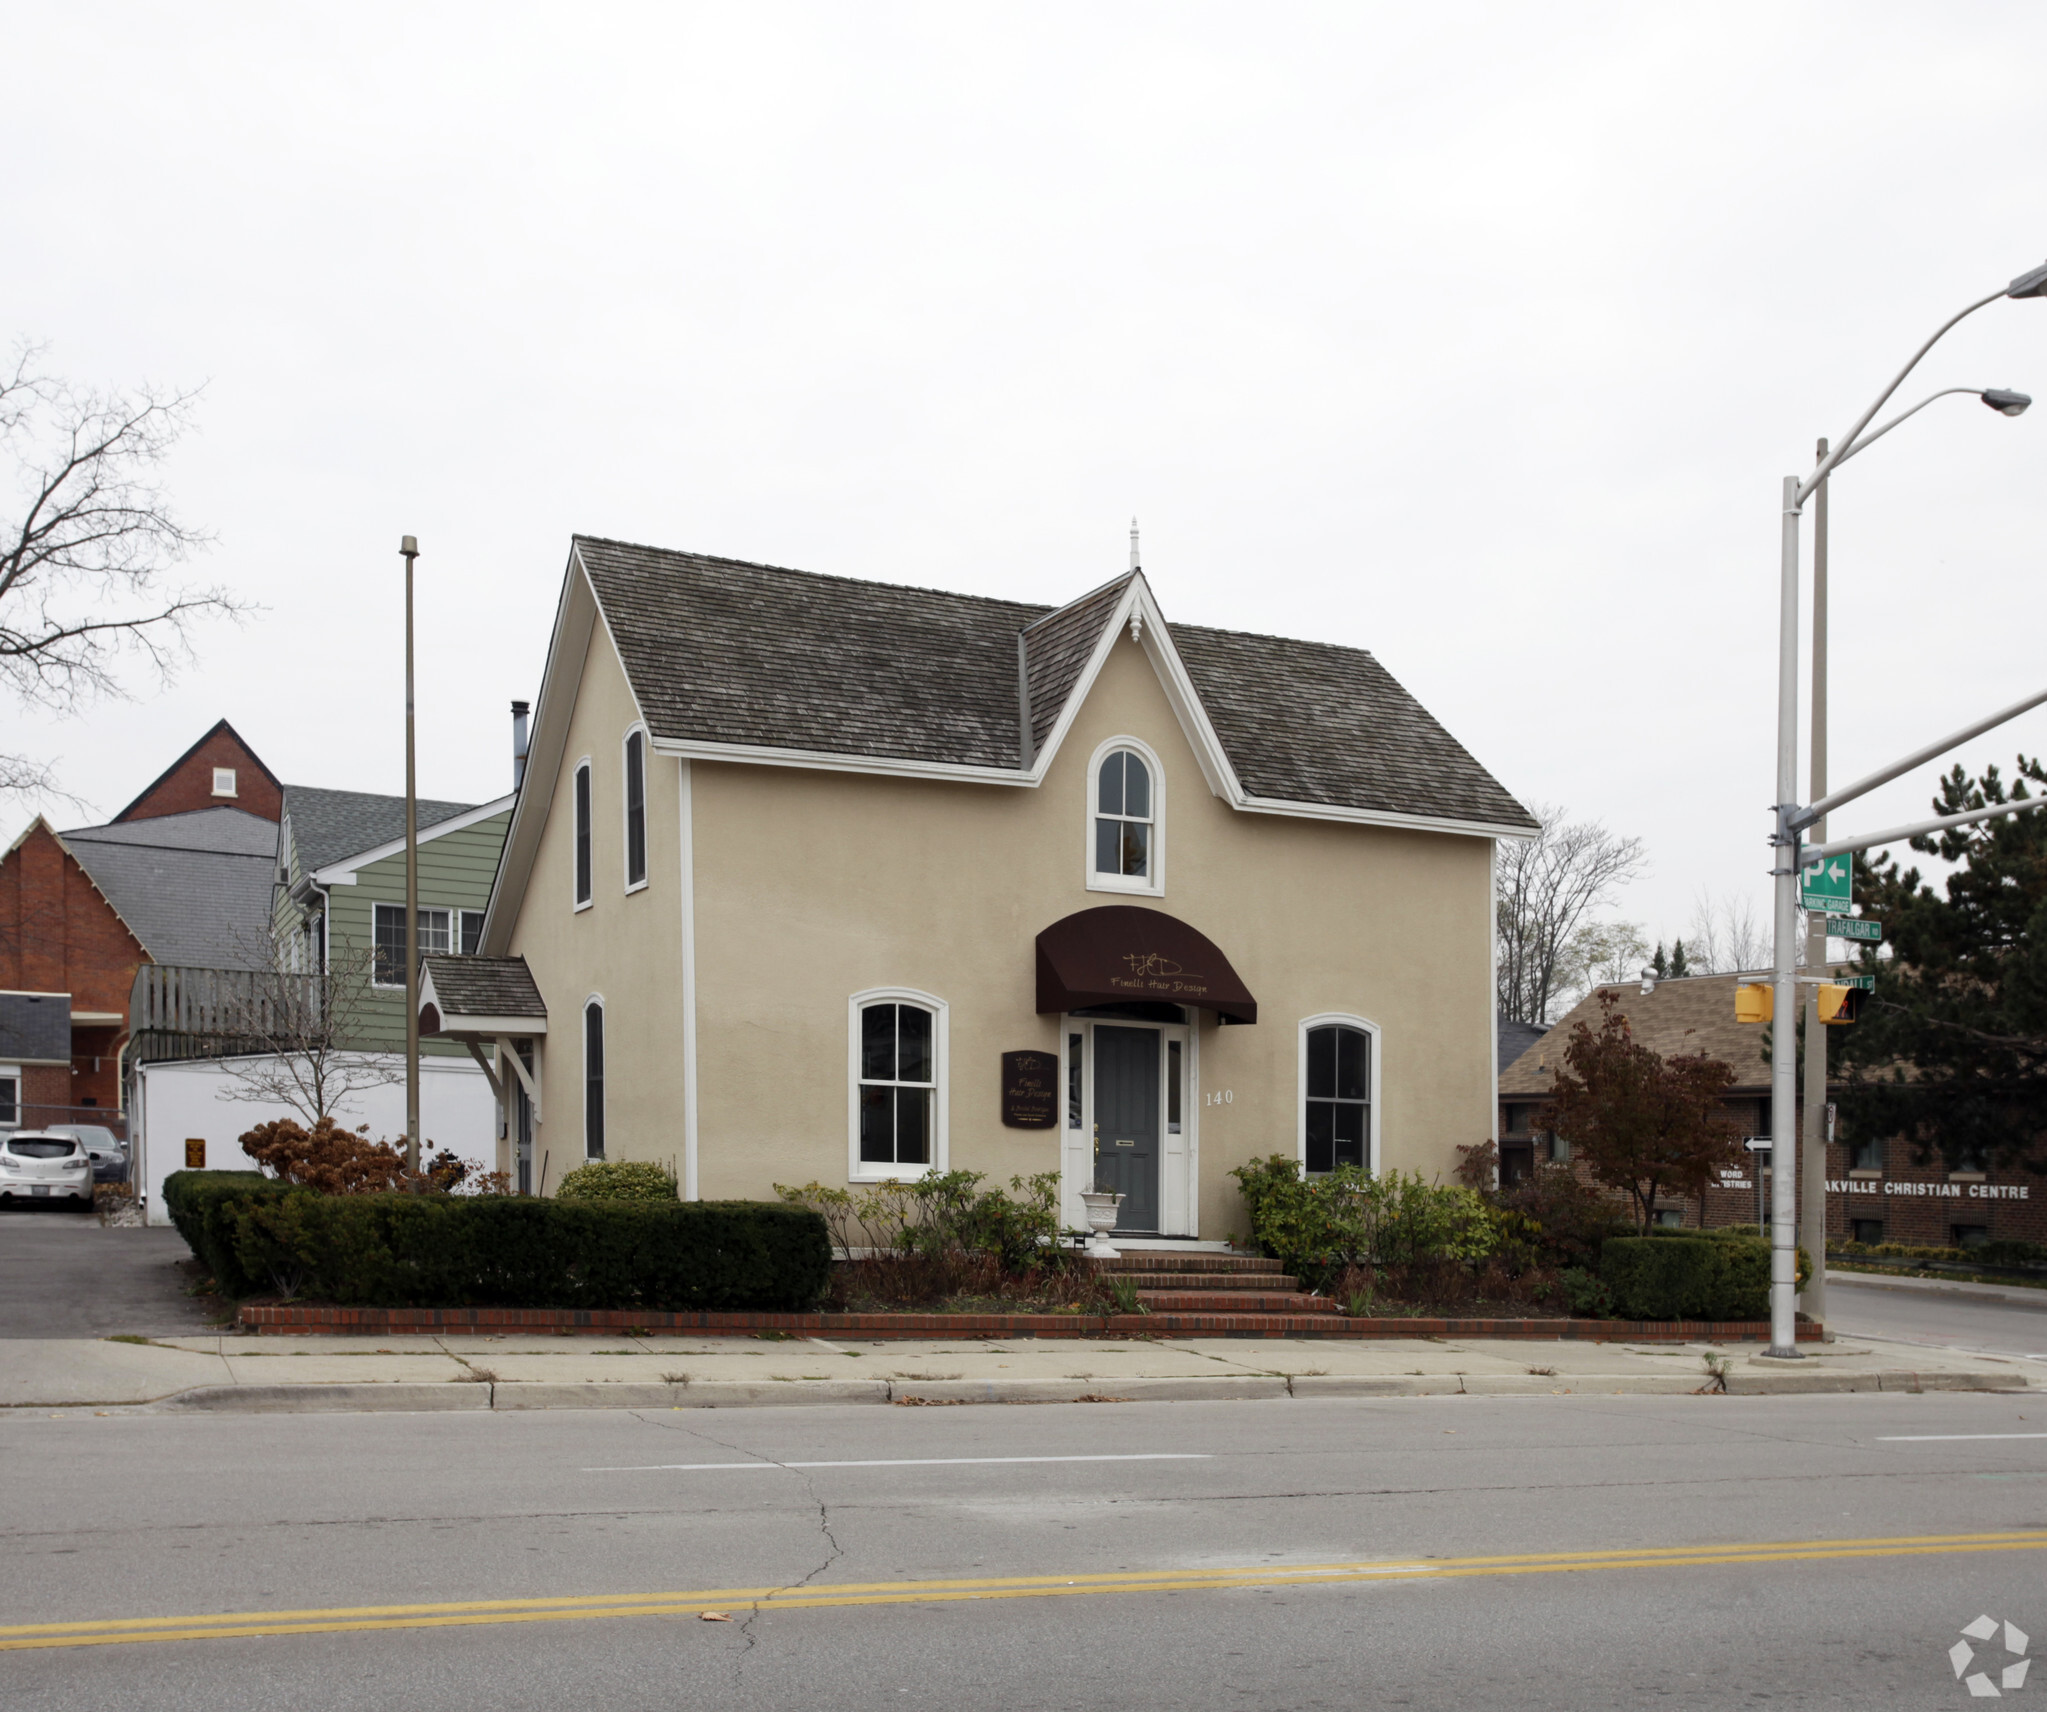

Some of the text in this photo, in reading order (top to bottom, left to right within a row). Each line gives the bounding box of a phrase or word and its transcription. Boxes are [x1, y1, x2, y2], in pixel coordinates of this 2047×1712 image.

[1828, 899, 1849, 912] GARAGE
[1827, 919, 1870, 937] TRAFALGAR
[1110, 976, 1208, 997] Finelli Hair Design
[1206, 1089, 1233, 1107] 140
[1720, 1170, 1743, 1179] WORD
[1885, 1182, 1960, 1197] CHRISTIAN
[1969, 1184, 2029, 1199] CENTRE
